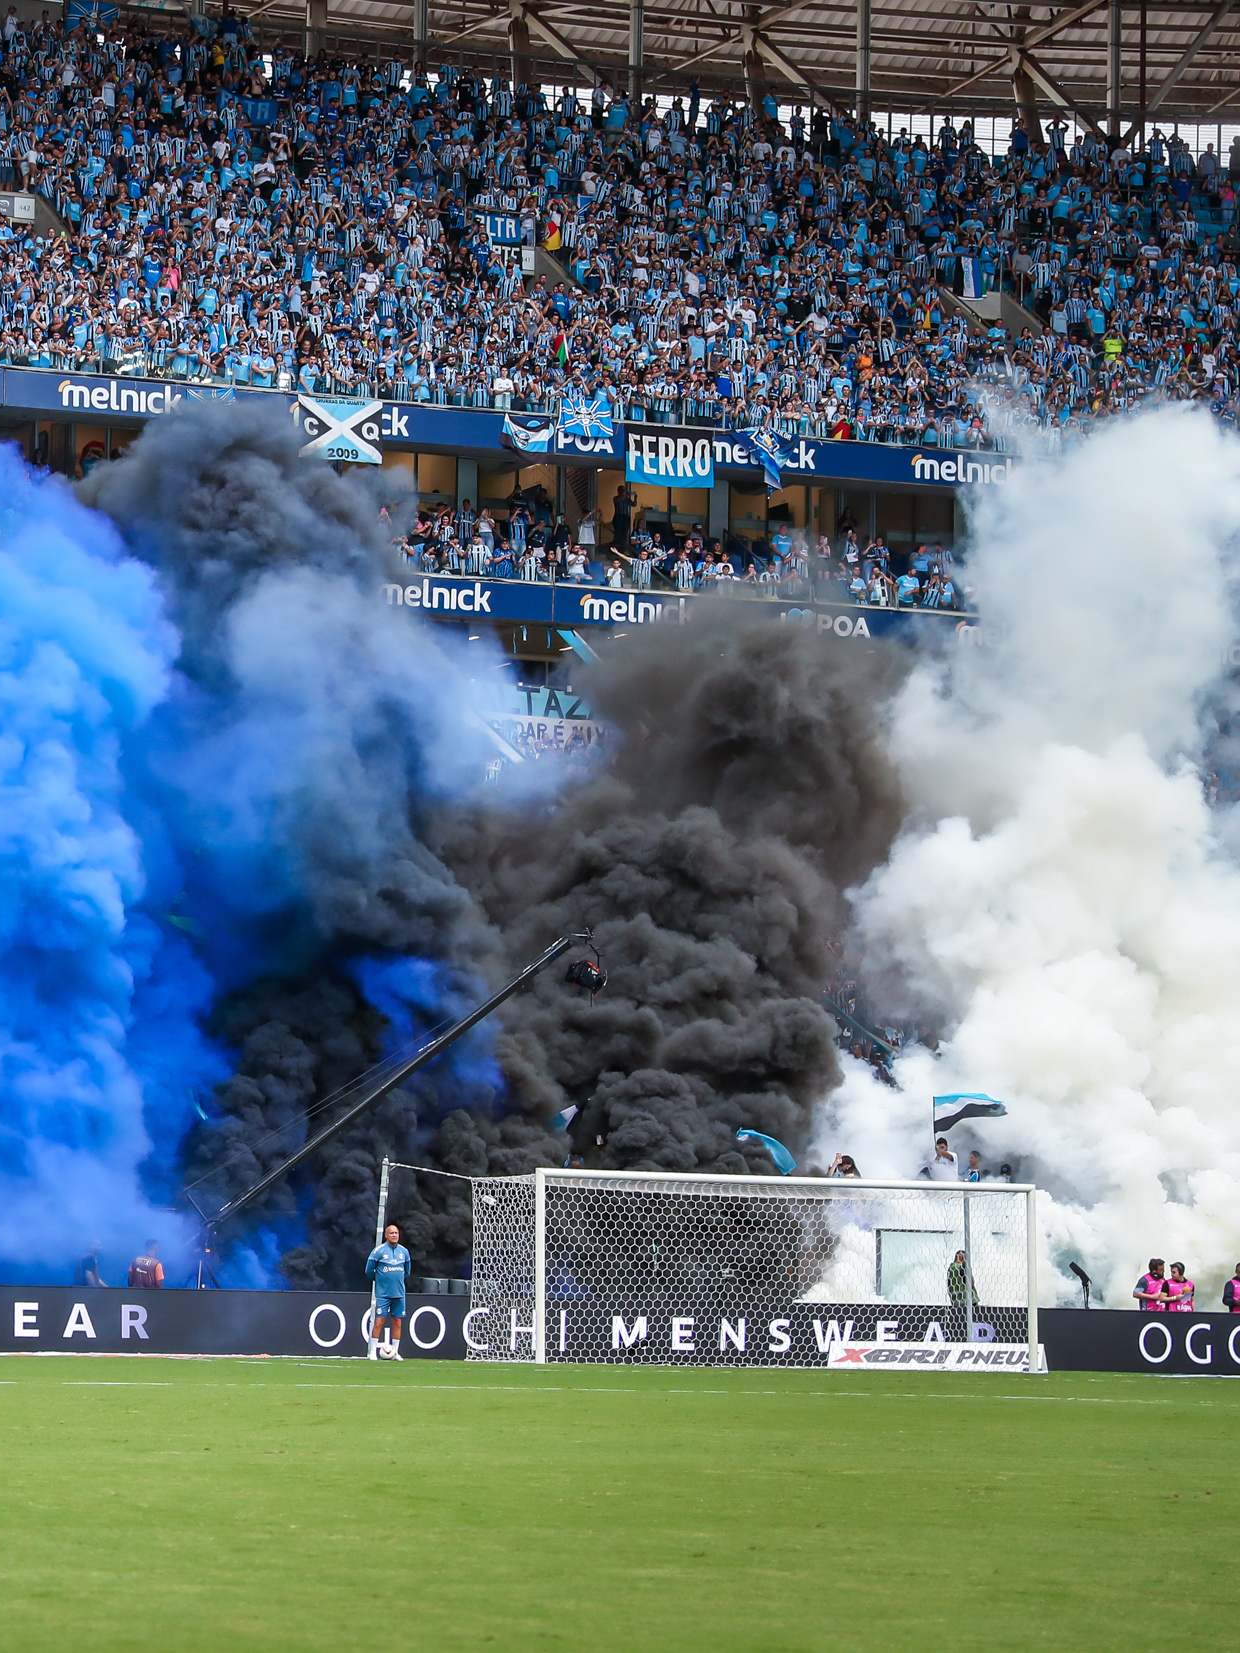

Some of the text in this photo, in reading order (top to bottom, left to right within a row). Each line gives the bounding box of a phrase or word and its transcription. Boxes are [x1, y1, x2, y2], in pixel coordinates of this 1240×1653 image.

[60, 379, 182, 415] melnick
[303, 417, 320, 436] C
[361, 421, 380, 441] Q
[327, 447, 359, 459] 2009
[627, 432, 711, 478] FERRO
[816, 613, 871, 639] POA
